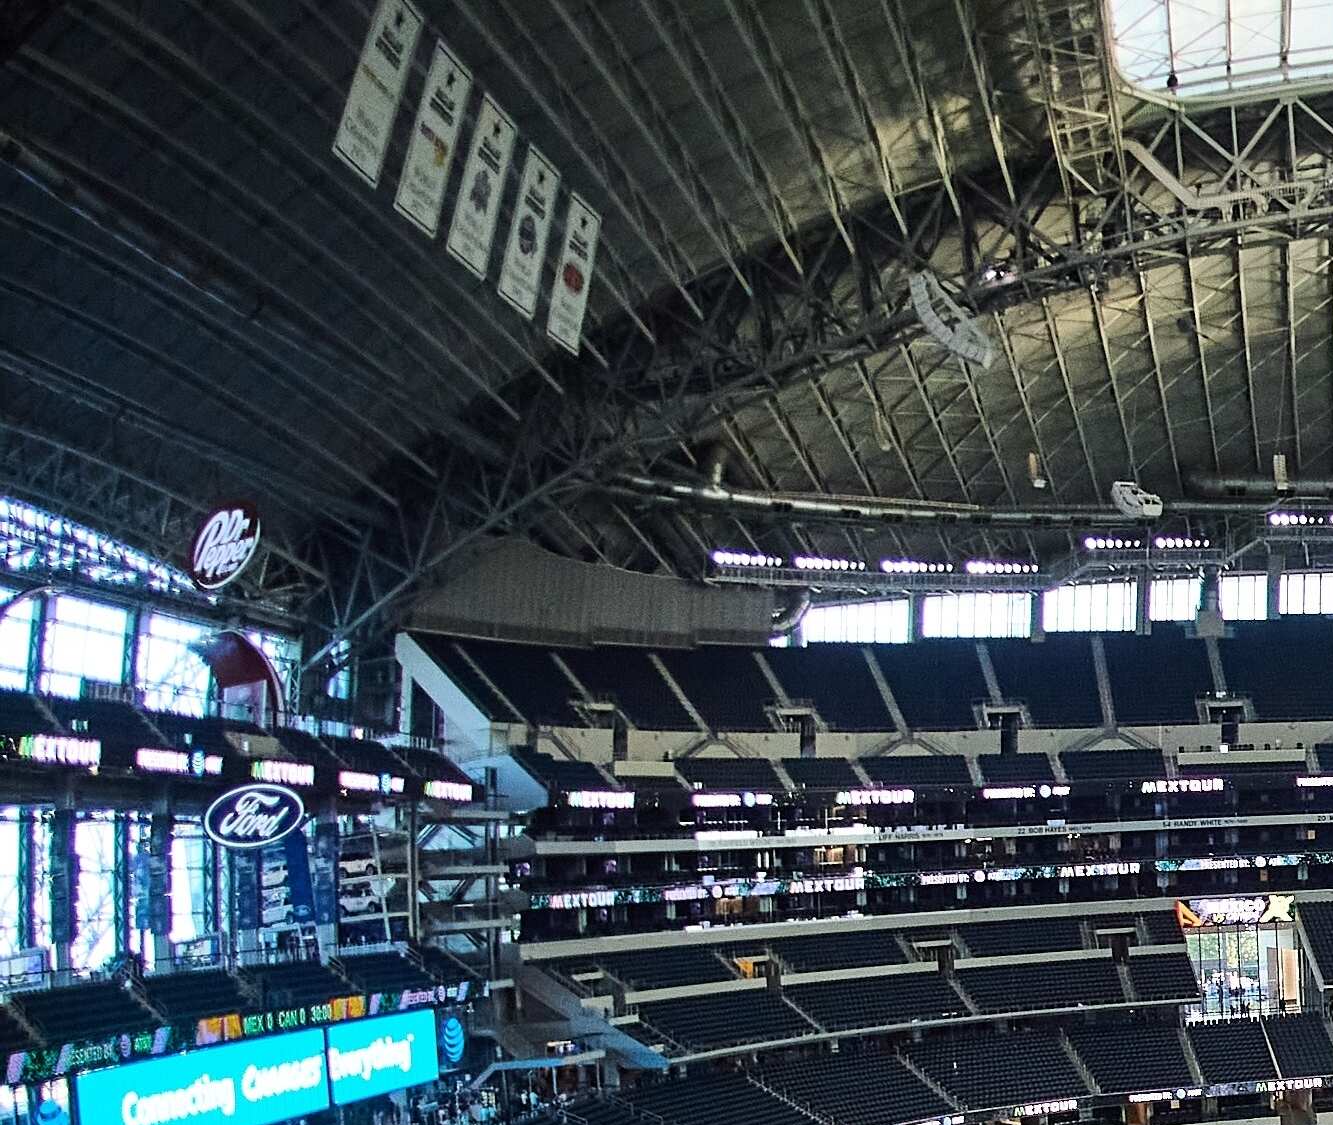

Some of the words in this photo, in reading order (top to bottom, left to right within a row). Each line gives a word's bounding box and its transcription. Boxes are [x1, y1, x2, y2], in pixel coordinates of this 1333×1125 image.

[194, 511, 254, 578] Pepper
[1142, 778, 1225, 794] MEXTOUR
[835, 789, 915, 805] MEXTOUR
[219, 791, 281, 837] Ford
[1200, 818, 1222, 826] WHITE
[1060, 862, 1141, 878] MEXTOUR
[789, 874, 865, 894] MEXTOUR
[548, 890, 616, 909] MEXTOUR
[243, 1014, 264, 1034] MEX
[266, 1011, 274, 1028] 0
[278, 1007, 299, 1028] CAN
[300, 1006, 306, 1023] 0
[1255, 1077, 1323, 1093] MEXTOUR
[1013, 1099, 1078, 1117] MEXTOUR
